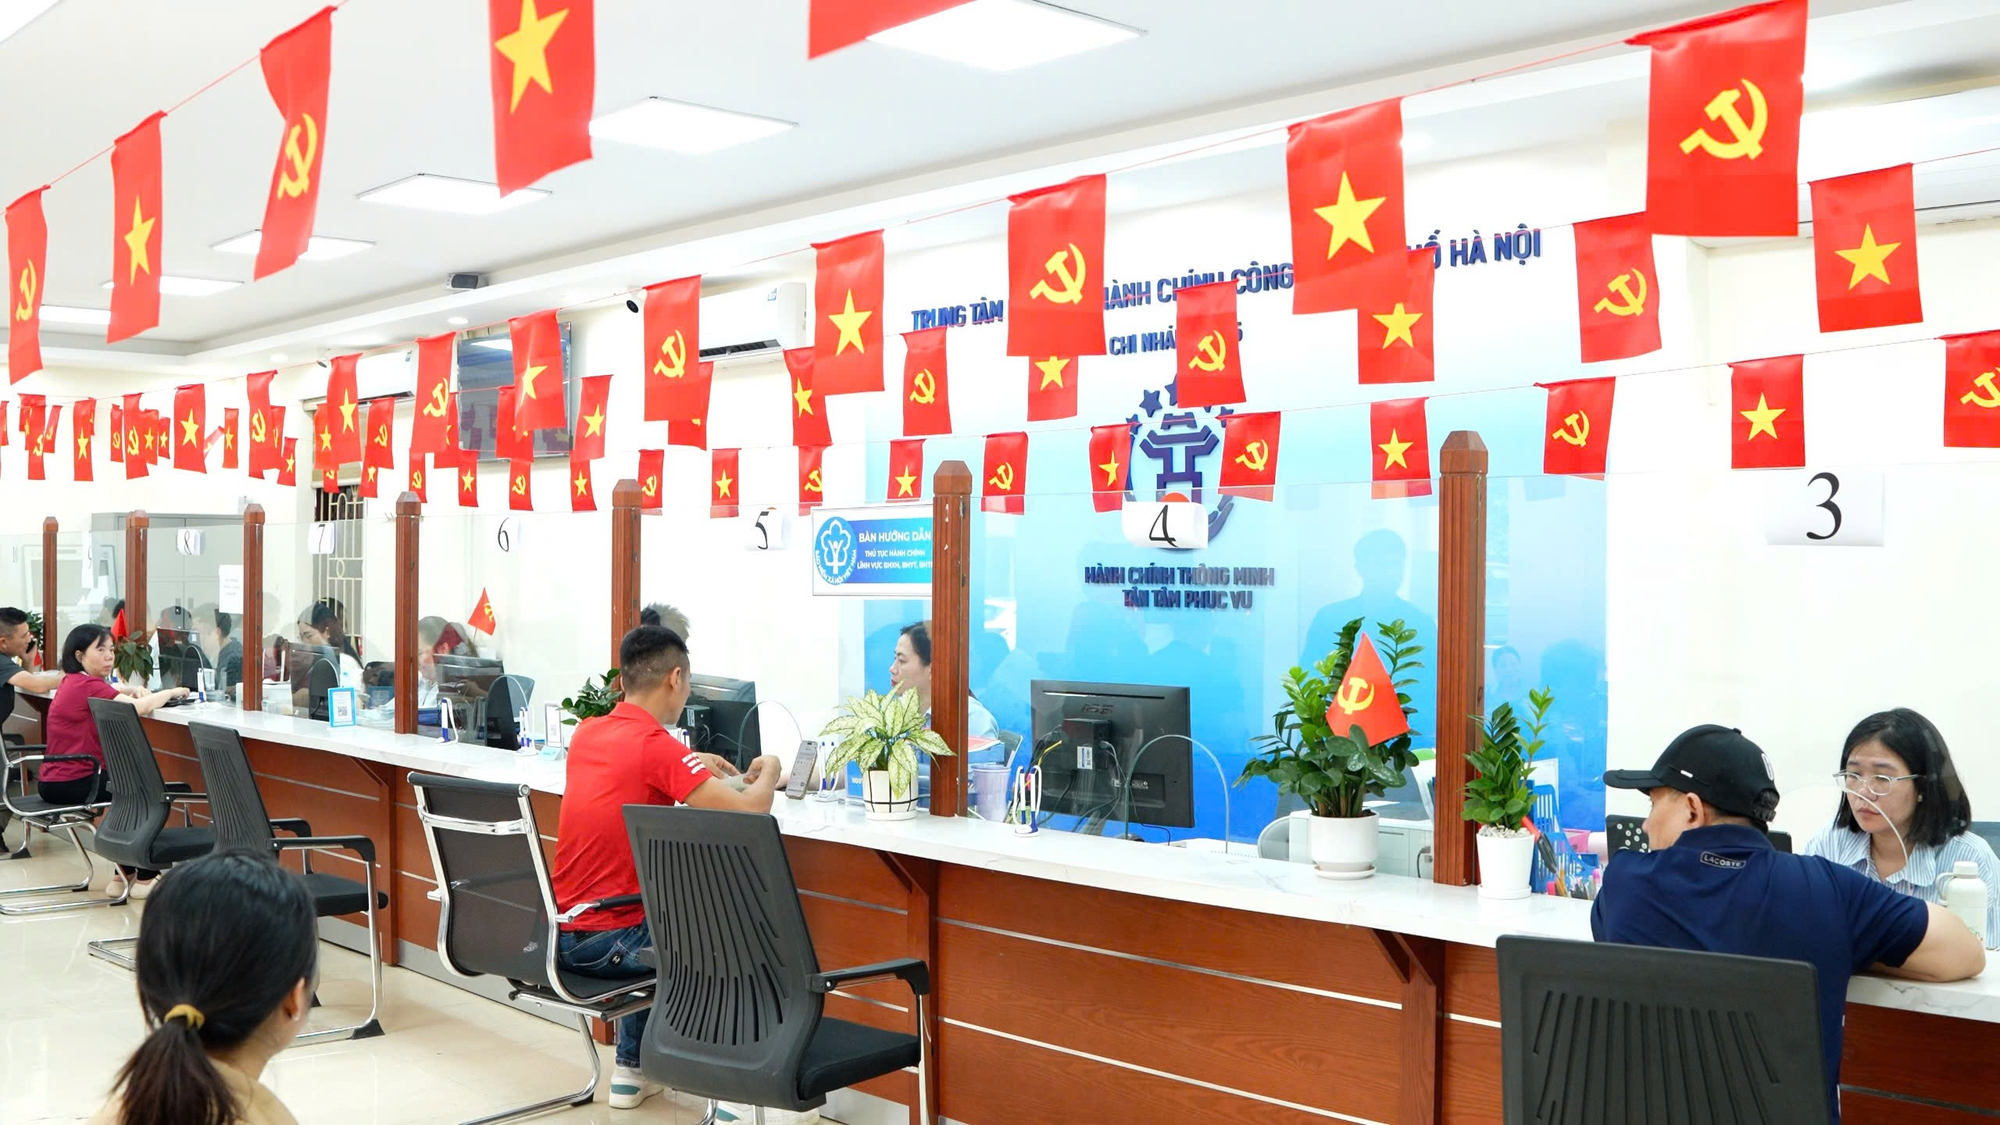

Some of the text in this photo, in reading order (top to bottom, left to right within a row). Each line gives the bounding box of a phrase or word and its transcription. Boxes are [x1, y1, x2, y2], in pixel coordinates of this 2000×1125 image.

[911, 305, 967, 331] TRUNG
[969, 297, 1004, 325] TÂM
[1231, 261, 1294, 295] CÔNG
[1450, 229, 1488, 267] HÀ
[1494, 223, 1541, 266] NỘI
[1109, 325, 1176, 355] CHI NHÁ
[1806, 471, 1842, 540] 3
[318, 523, 327, 553] 7
[497, 517, 510, 552] 6
[755, 510, 769, 550] 5
[858, 527, 932, 543] BÀN HƯỚNG DẪN
[1149, 504, 1178, 547] 4
[184, 530, 192, 555] 8
[889, 548, 906, 557] HÀNH
[907, 549, 926, 557] CHÍNH
[1085, 563, 1275, 586] HÀNH CHÍNH THÔNG MINH
